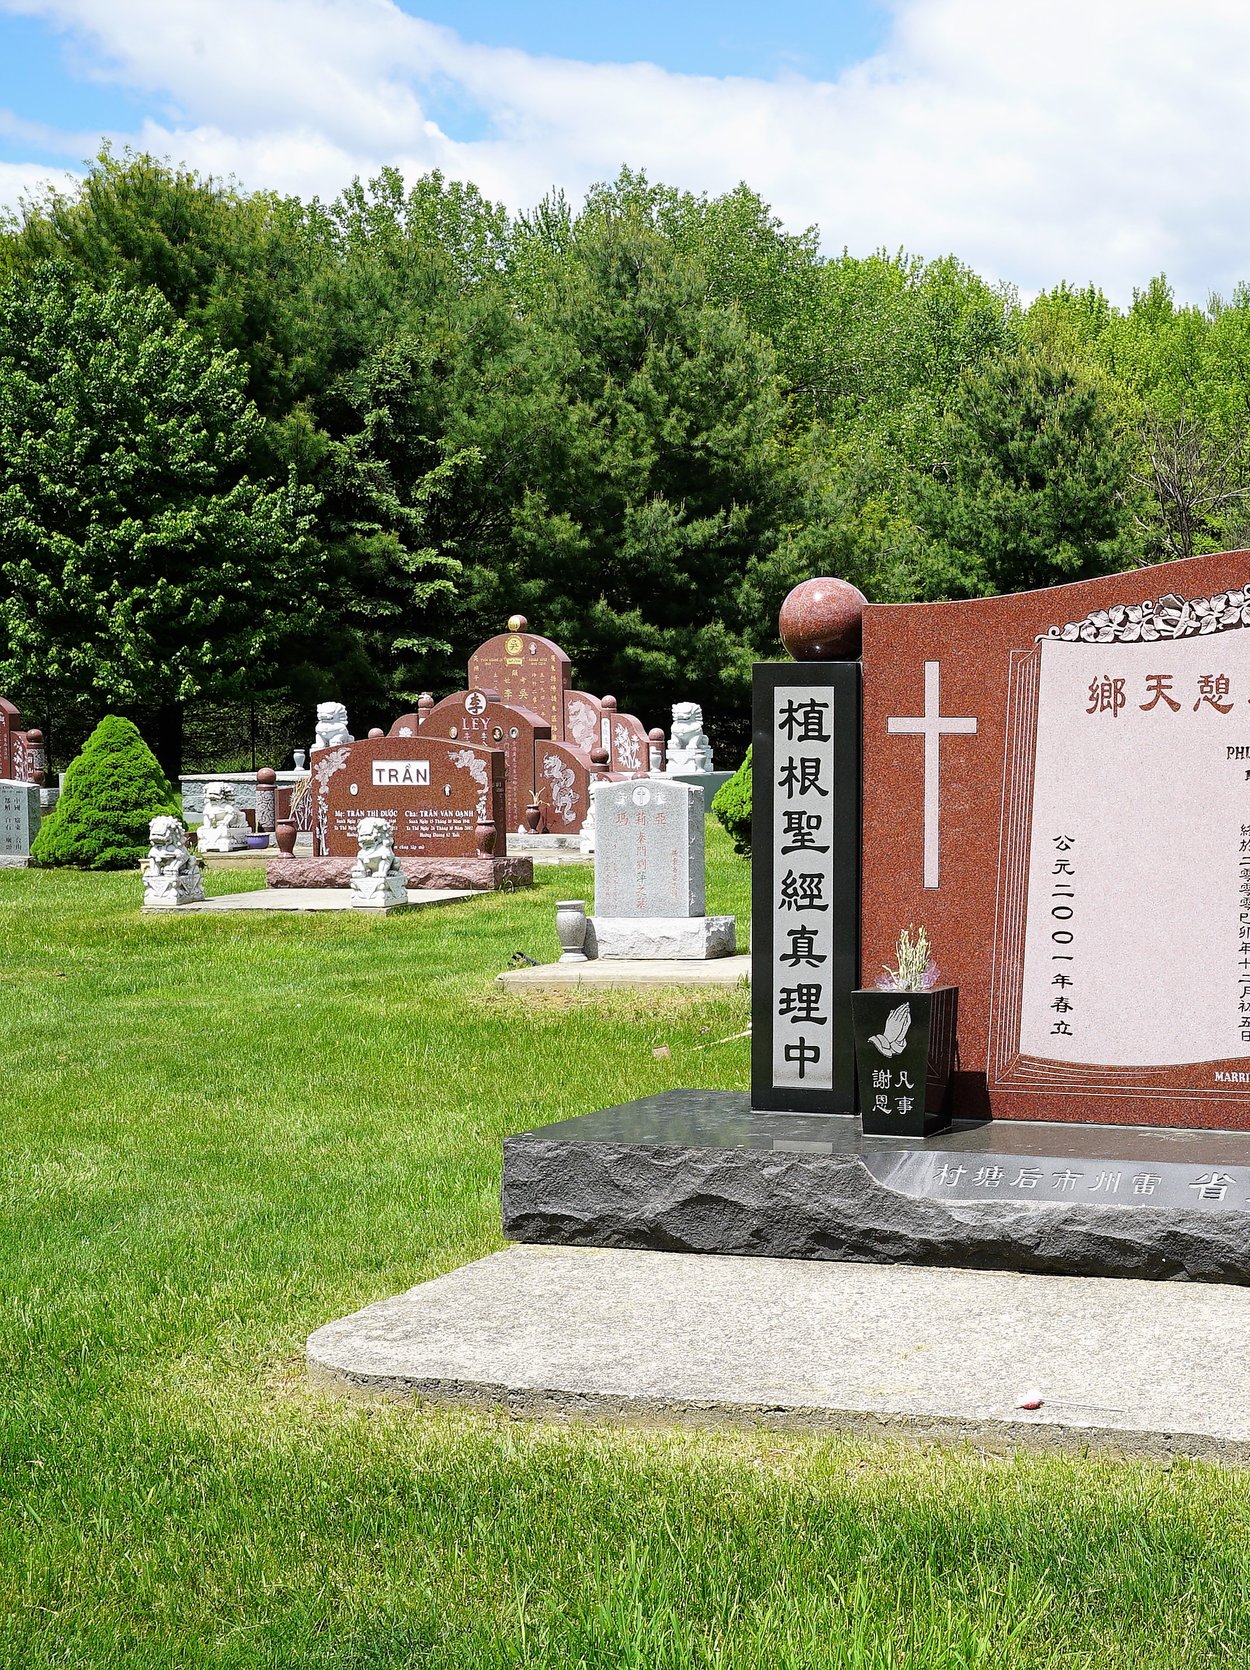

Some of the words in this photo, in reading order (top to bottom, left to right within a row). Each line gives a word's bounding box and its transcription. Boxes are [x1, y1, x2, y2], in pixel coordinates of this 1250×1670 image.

[462, 717, 491, 731] LEY
[375, 763, 427, 783] TRẦN
[778, 697, 832, 1079] 植根聖經真理中
[872, 1069, 892, 1115] 謝恩
[894, 1070, 915, 1115] 凡事
